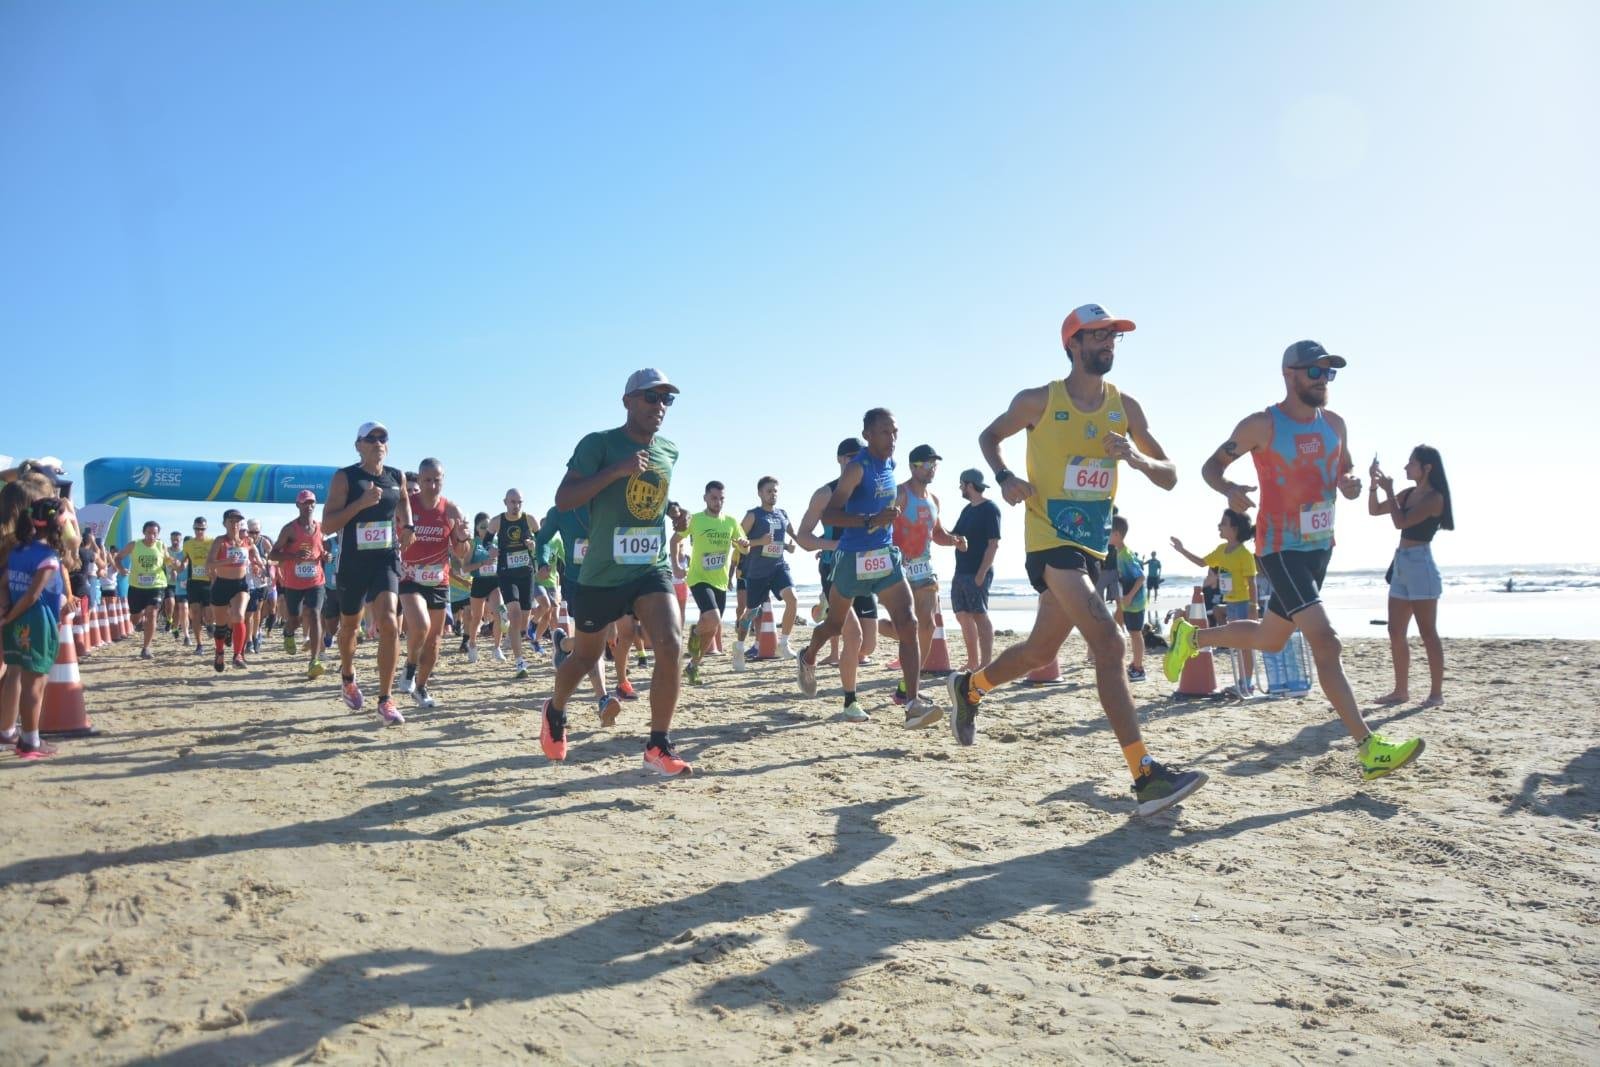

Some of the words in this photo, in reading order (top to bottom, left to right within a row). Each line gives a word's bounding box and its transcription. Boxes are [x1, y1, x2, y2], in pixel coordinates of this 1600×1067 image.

[154, 473, 182, 482] SESC
[1076, 470, 1110, 489] 640
[364, 529, 387, 541] 621
[620, 538, 659, 554] 1094
[864, 558, 886, 571] 695
[909, 563, 929, 575] 1071
